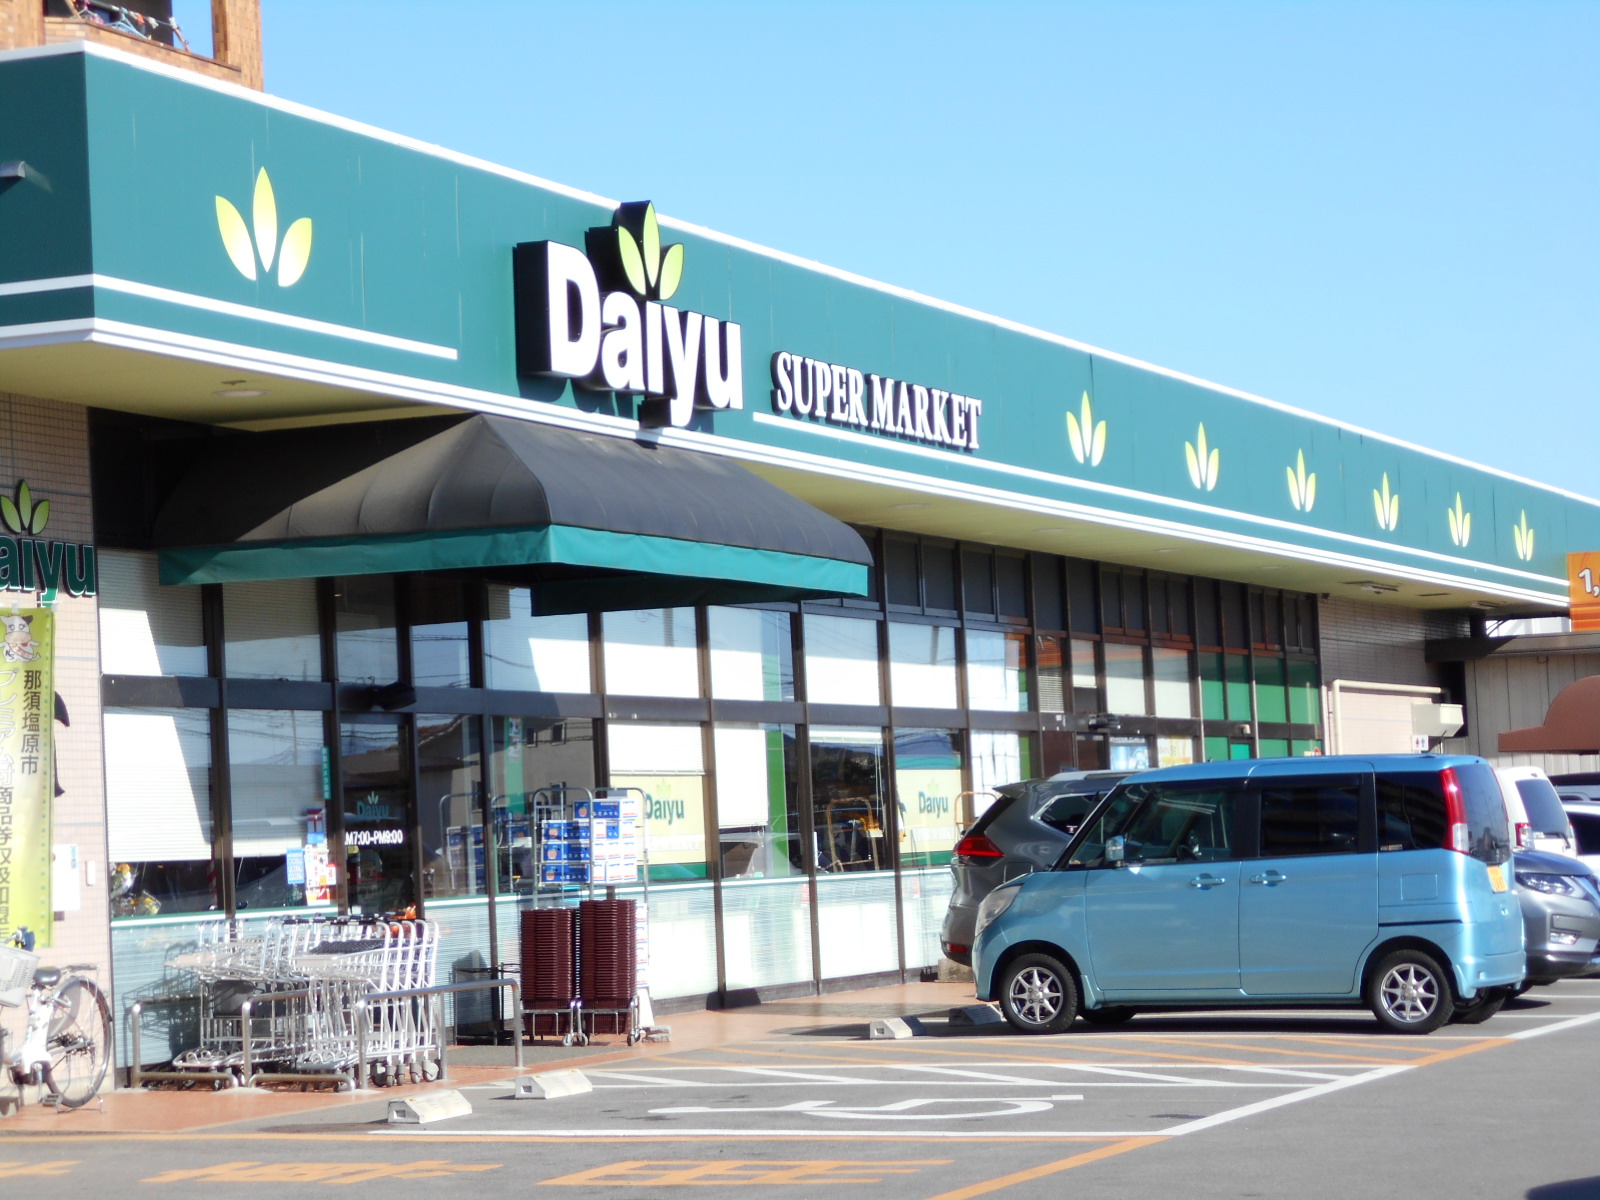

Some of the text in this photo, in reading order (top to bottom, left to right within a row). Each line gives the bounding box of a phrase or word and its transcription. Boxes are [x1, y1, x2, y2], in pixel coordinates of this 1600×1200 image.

[546, 240, 744, 427] Daiyu
[774, 350, 982, 450] SUPER MARKET
[21, 670, 42, 775] 那須塩原市
[357, 801, 390, 823] Daiyu
[644, 793, 685, 826] Daiyu
[918, 791, 949, 819] Daiyu
